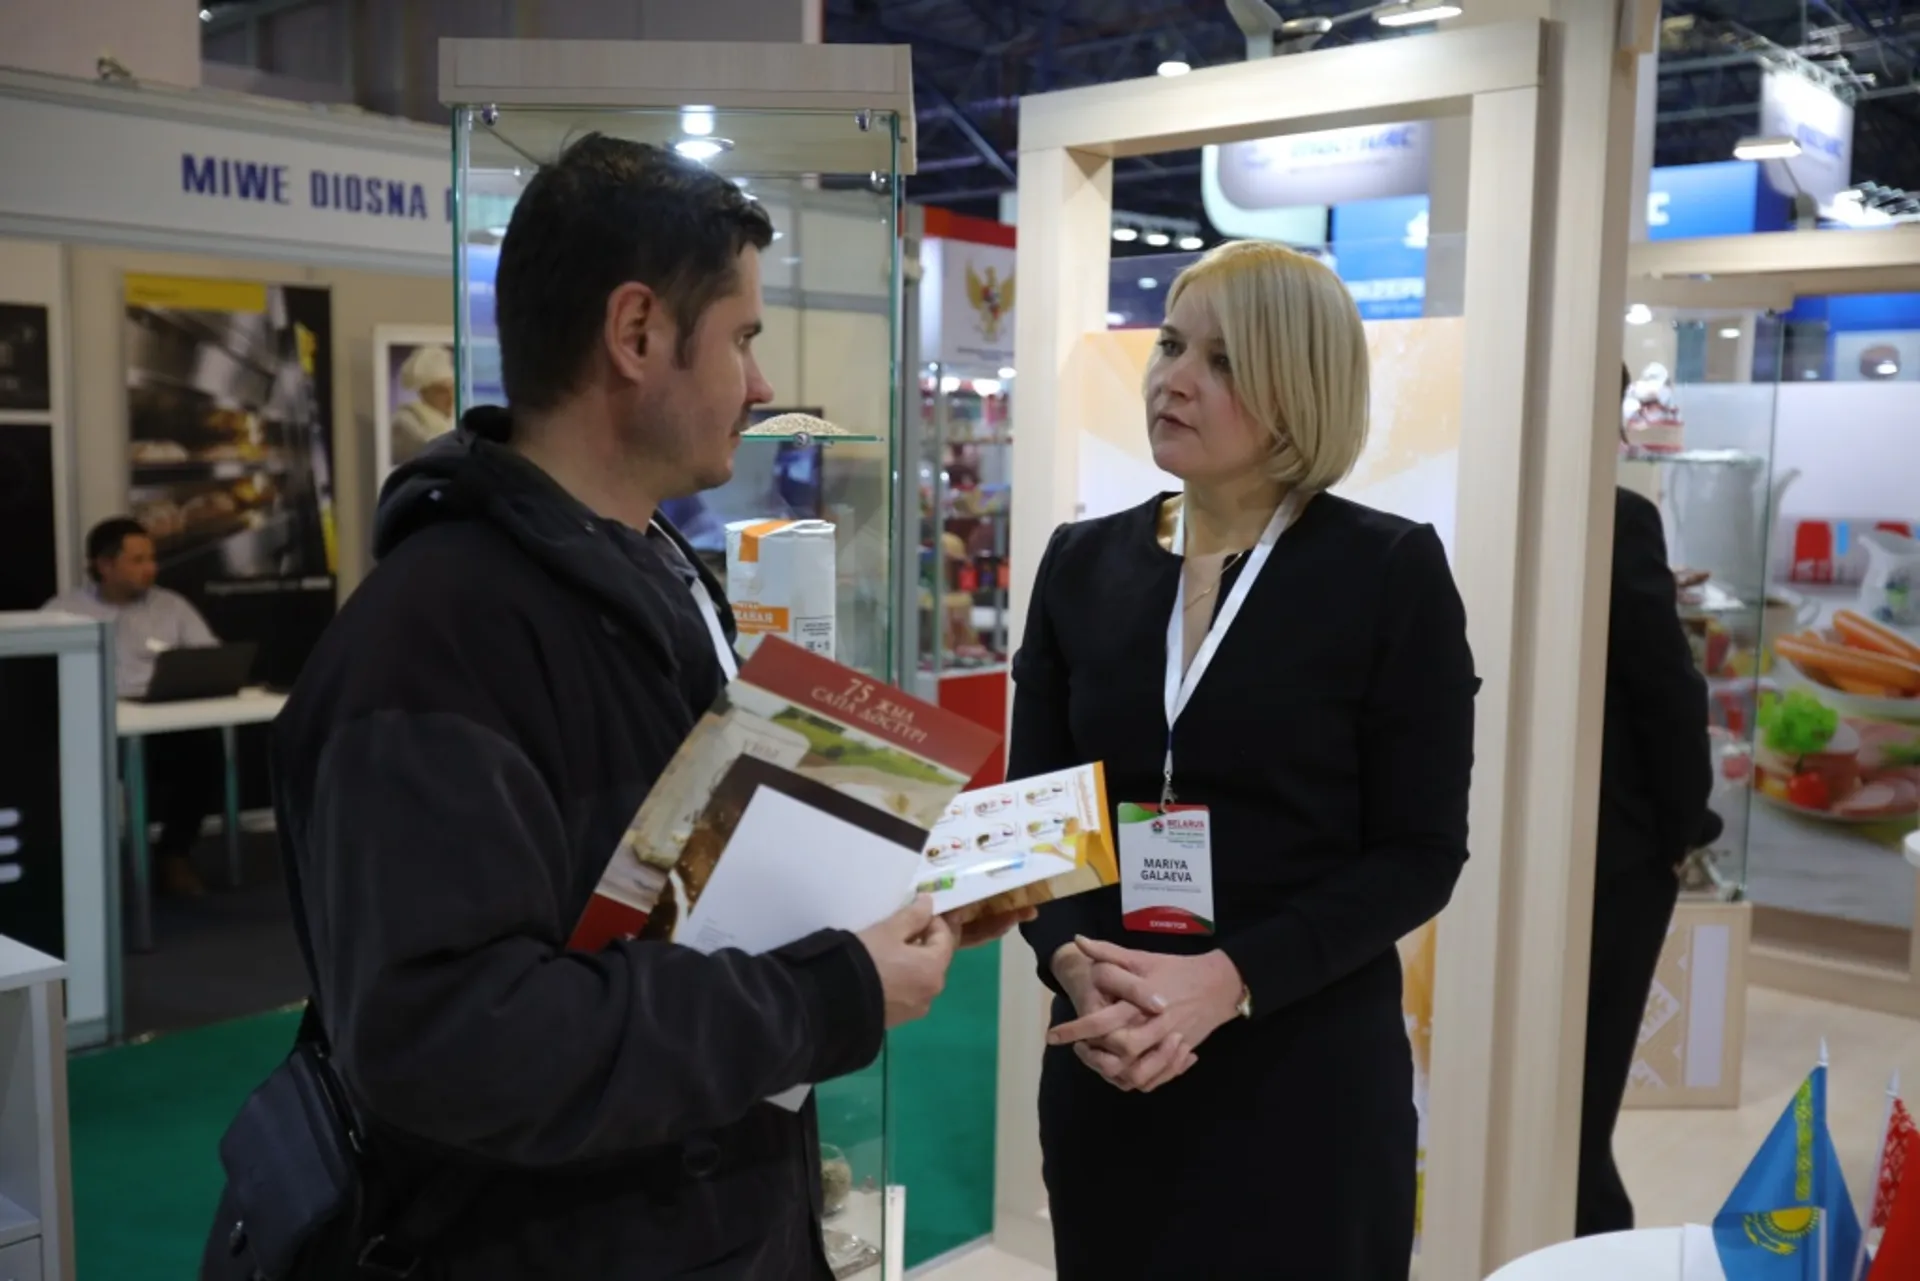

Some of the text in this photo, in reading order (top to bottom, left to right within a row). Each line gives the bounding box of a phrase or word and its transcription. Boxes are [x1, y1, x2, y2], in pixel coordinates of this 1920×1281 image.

[182, 154, 291, 206] MIWE
[310, 170, 429, 220] DIOSNA
[843, 678, 876, 703] 75
[1143, 858, 1188, 870] MARIYA
[1141, 870, 1193, 882] GALAEVA
